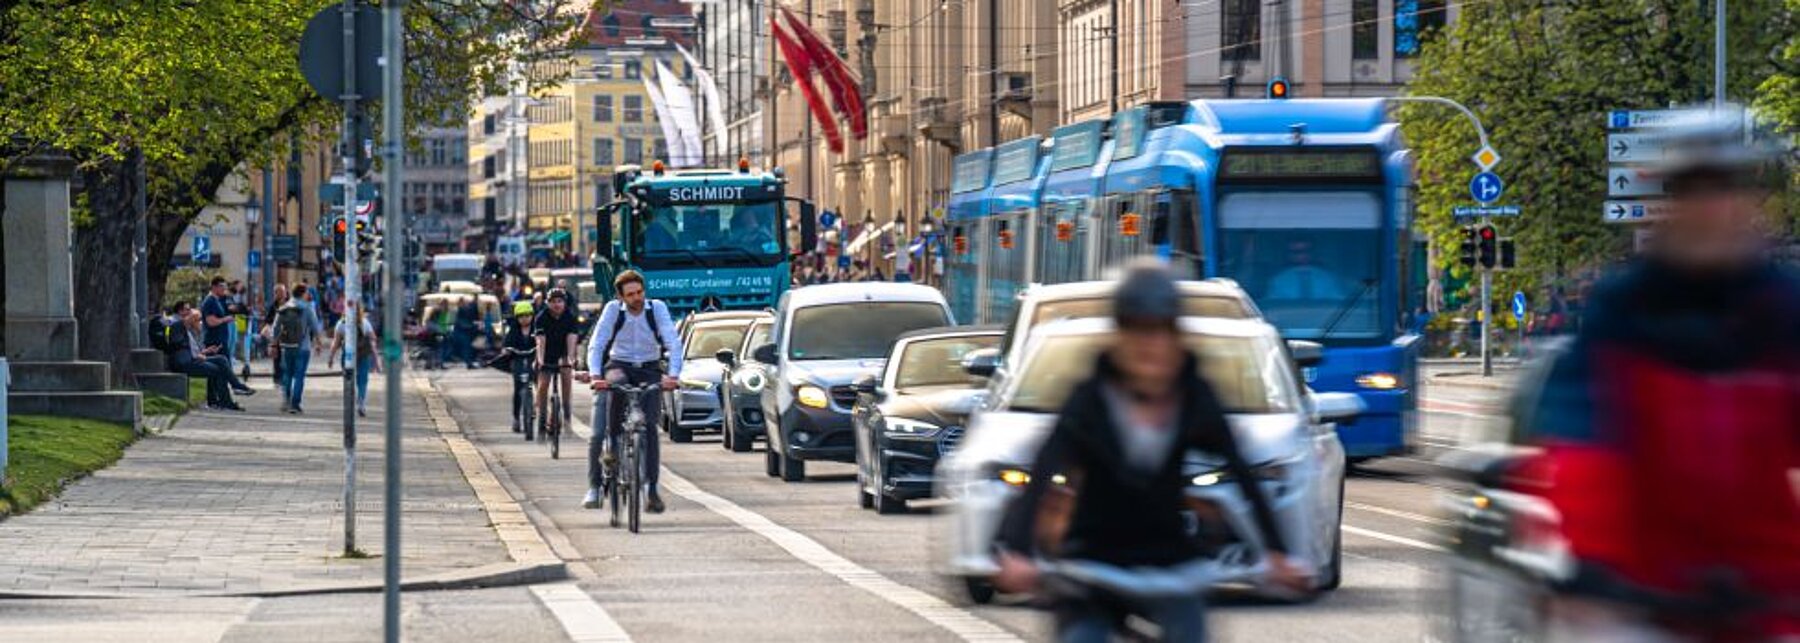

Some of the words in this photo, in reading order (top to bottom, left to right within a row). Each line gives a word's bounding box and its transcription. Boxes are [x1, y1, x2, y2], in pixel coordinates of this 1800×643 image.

[669, 186, 744, 201] SCHMIDT
[648, 278, 690, 289] SCHMIDT
[691, 278, 732, 288] Container
